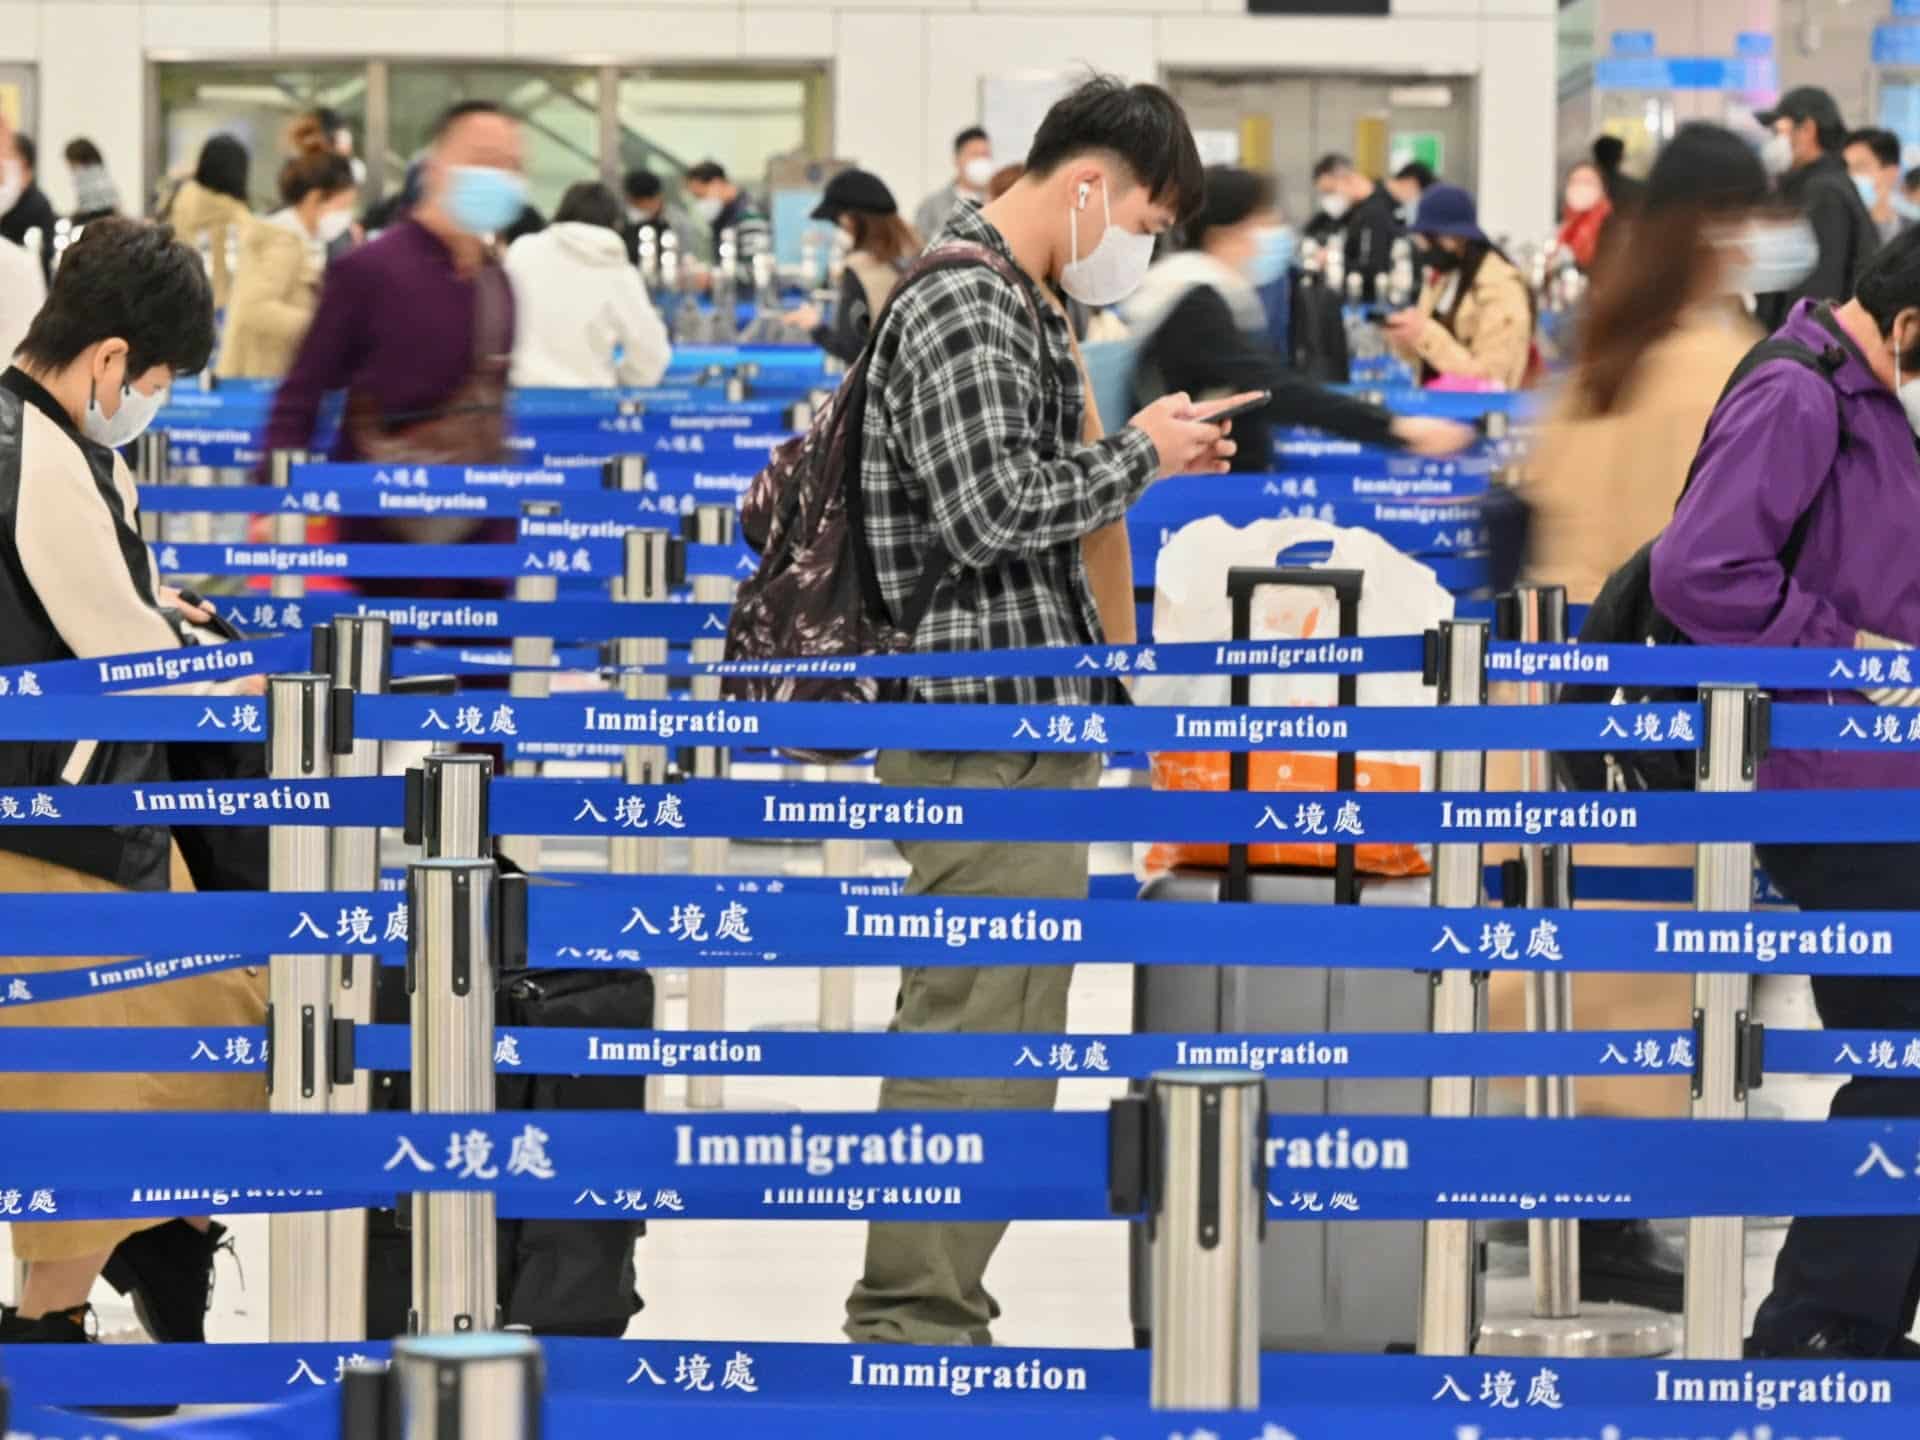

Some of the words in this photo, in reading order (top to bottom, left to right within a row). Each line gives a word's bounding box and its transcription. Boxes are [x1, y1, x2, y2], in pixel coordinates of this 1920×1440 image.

[376, 468, 428, 487] 入境處
[465, 468, 564, 487] Immigration
[1266, 478, 1316, 497] 入境處
[1353, 477, 1452, 495] Immigration
[282, 492, 341, 512] 入境處
[379, 492, 487, 512] Immigration
[225, 546, 348, 568] Immigration
[525, 549, 591, 572] 入境處
[227, 604, 302, 628] 入境處
[100, 651, 253, 683] Immigration
[1075, 649, 1157, 672] 入境處
[1216, 643, 1364, 667] Immigration
[1485, 648, 1609, 671] migration
[1829, 655, 1912, 683] 入境處
[421, 704, 517, 735] 入境處
[585, 707, 759, 738] Immigration
[1013, 713, 1108, 744] 入境處
[1176, 714, 1348, 744] Immigration
[1599, 709, 1695, 742] 入境處
[133, 786, 330, 816] Immigration
[574, 793, 685, 829] 入境處
[763, 795, 963, 830] Immigration
[1255, 799, 1364, 835] 入境處
[1441, 801, 1637, 834] Immigration
[621, 901, 753, 943] 入境處
[845, 905, 1082, 947] Immigration
[1431, 919, 1563, 961] 入境處
[1655, 921, 1892, 962] Immigration
[588, 1036, 761, 1067] Immigration
[1014, 1041, 1110, 1072] 入境處
[1176, 1042, 1349, 1070] Immigration
[1600, 1038, 1694, 1068] 入境處
[385, 1125, 555, 1179] 入境處
[676, 1124, 983, 1175] Immigration
[1265, 1128, 1408, 1169] ration
[627, 1351, 758, 1393] 入境處
[851, 1354, 1086, 1396] Immigration
[1433, 1367, 1562, 1409] 入境處
[1656, 1370, 1891, 1409] Immigration
